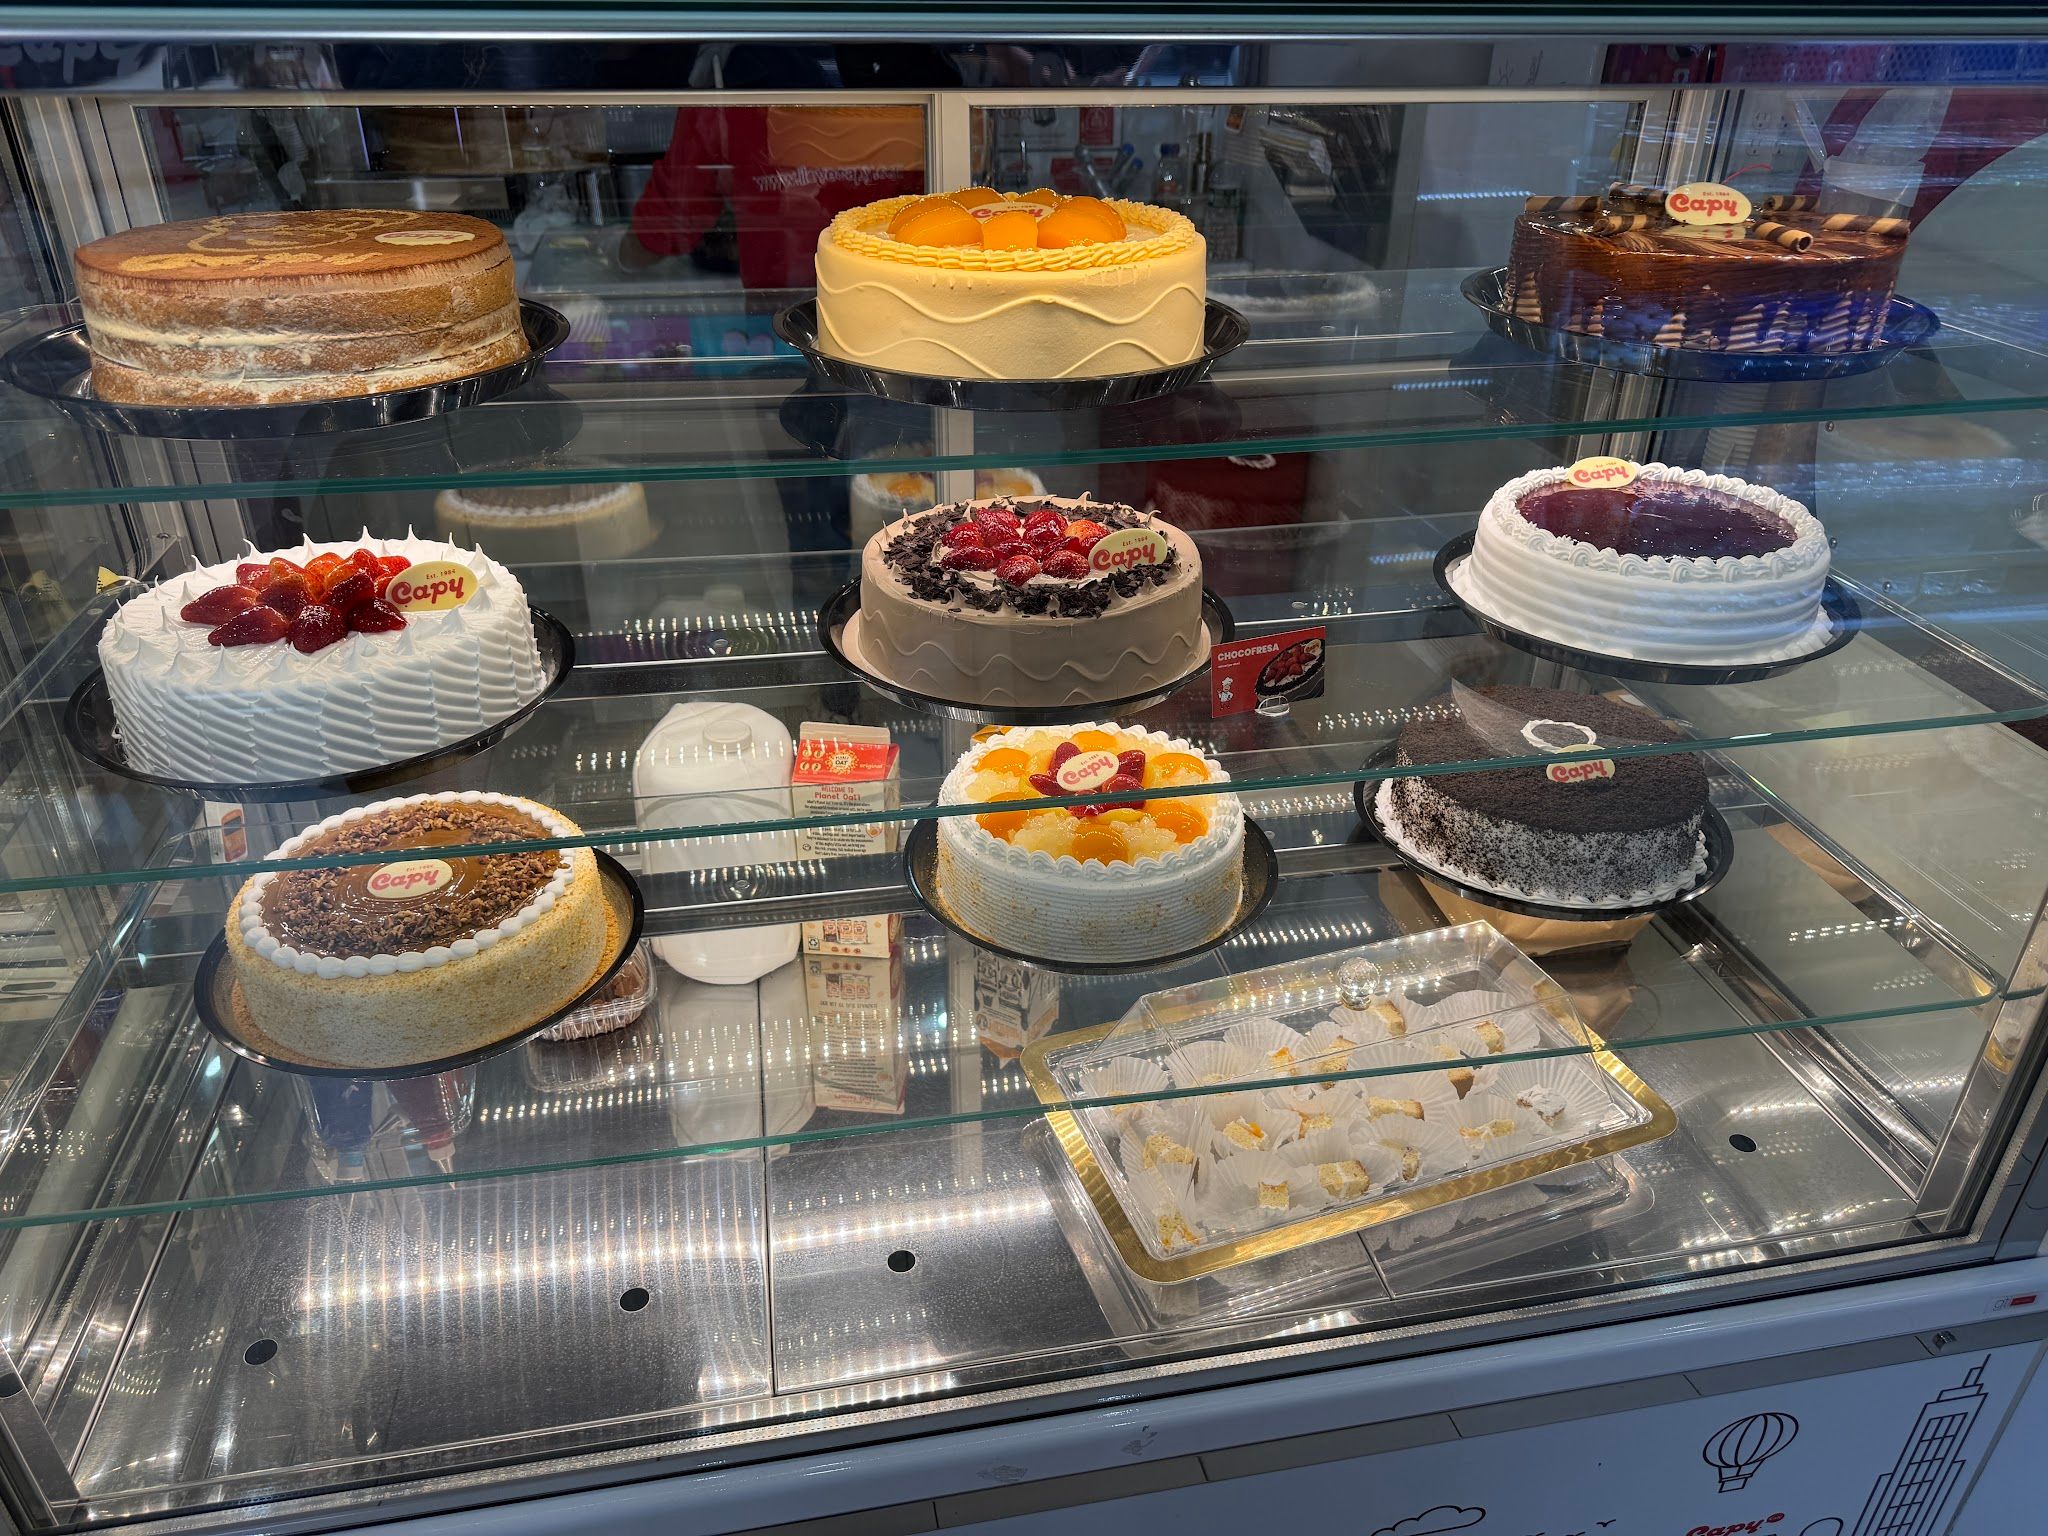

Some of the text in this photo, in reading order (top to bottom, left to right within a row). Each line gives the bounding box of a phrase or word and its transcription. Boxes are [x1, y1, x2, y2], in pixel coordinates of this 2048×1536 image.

[1669, 193, 1737, 217] Capy
[1573, 467, 1629, 483] Capy
[1093, 543, 1156, 571] Capy
[391, 577, 464, 605] Capy
[1217, 643, 1279, 661] CHOCOFRESA
[1062, 756, 1113, 785] Capy
[1551, 760, 1607, 783] Capy
[815, 792, 840, 800] Planet
[371, 869, 439, 891] Capy
